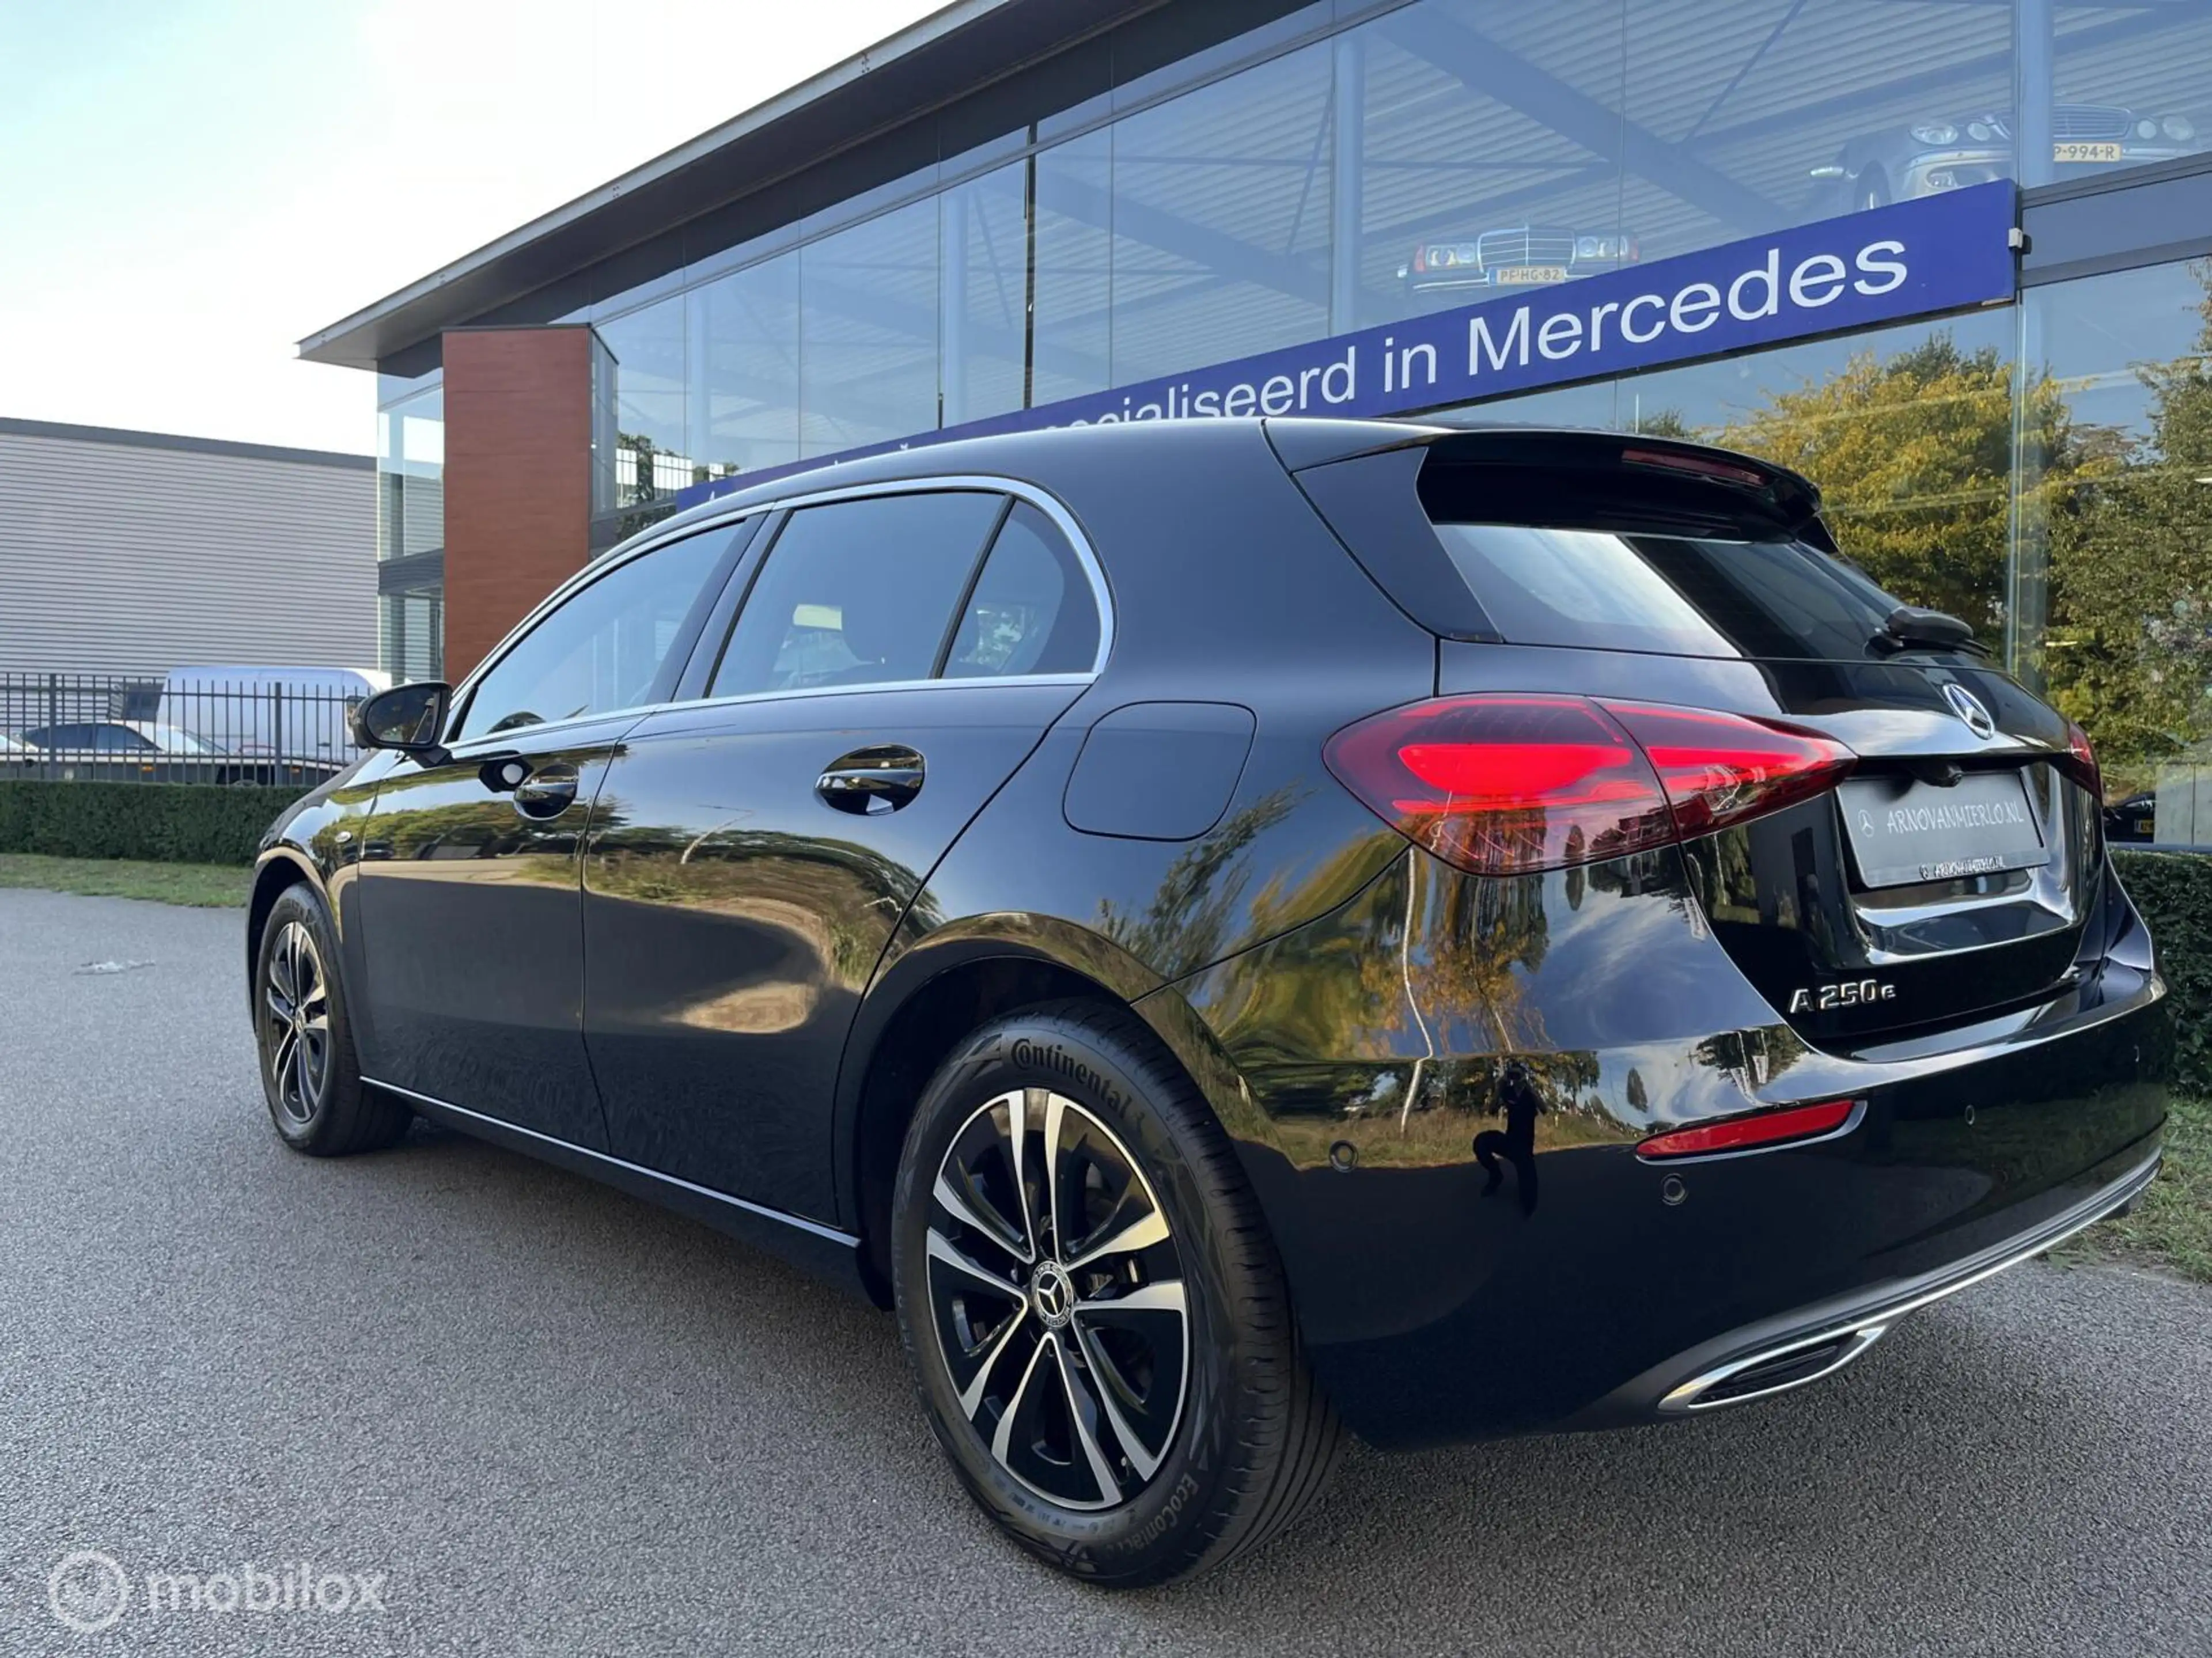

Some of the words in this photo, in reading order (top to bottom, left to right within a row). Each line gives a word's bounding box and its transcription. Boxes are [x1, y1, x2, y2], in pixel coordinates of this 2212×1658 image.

[1384, 337, 1436, 393] in
[1468, 240, 1907, 375] Mercedes
[1887, 801, 2024, 833] ARNOVANMIERLO.NL
[1789, 988, 1814, 1014] A
[1011, 1038, 1132, 1119] Continental
